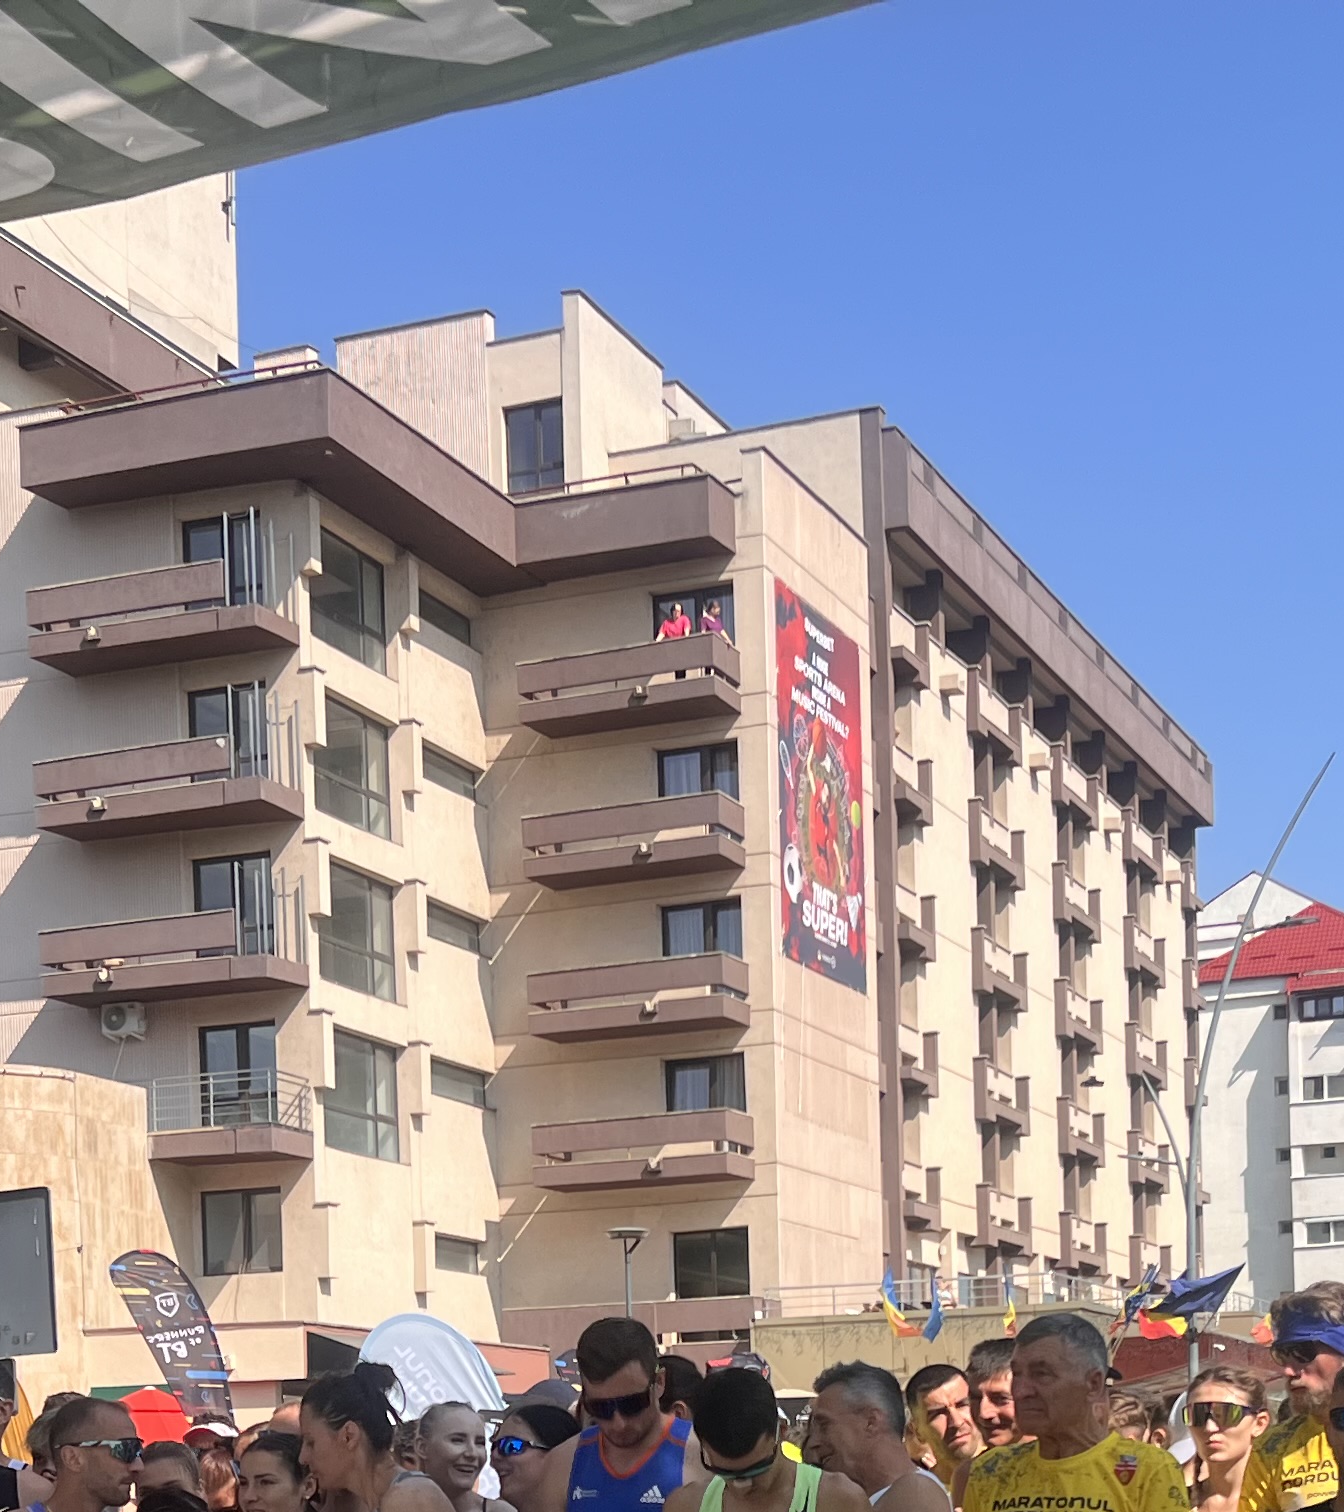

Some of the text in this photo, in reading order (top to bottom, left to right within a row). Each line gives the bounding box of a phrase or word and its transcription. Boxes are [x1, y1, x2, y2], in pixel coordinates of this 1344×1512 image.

[791, 685, 816, 715] MUSIC
[812, 880, 838, 915] THAT'S
[802, 899, 848, 947] SUPER!
